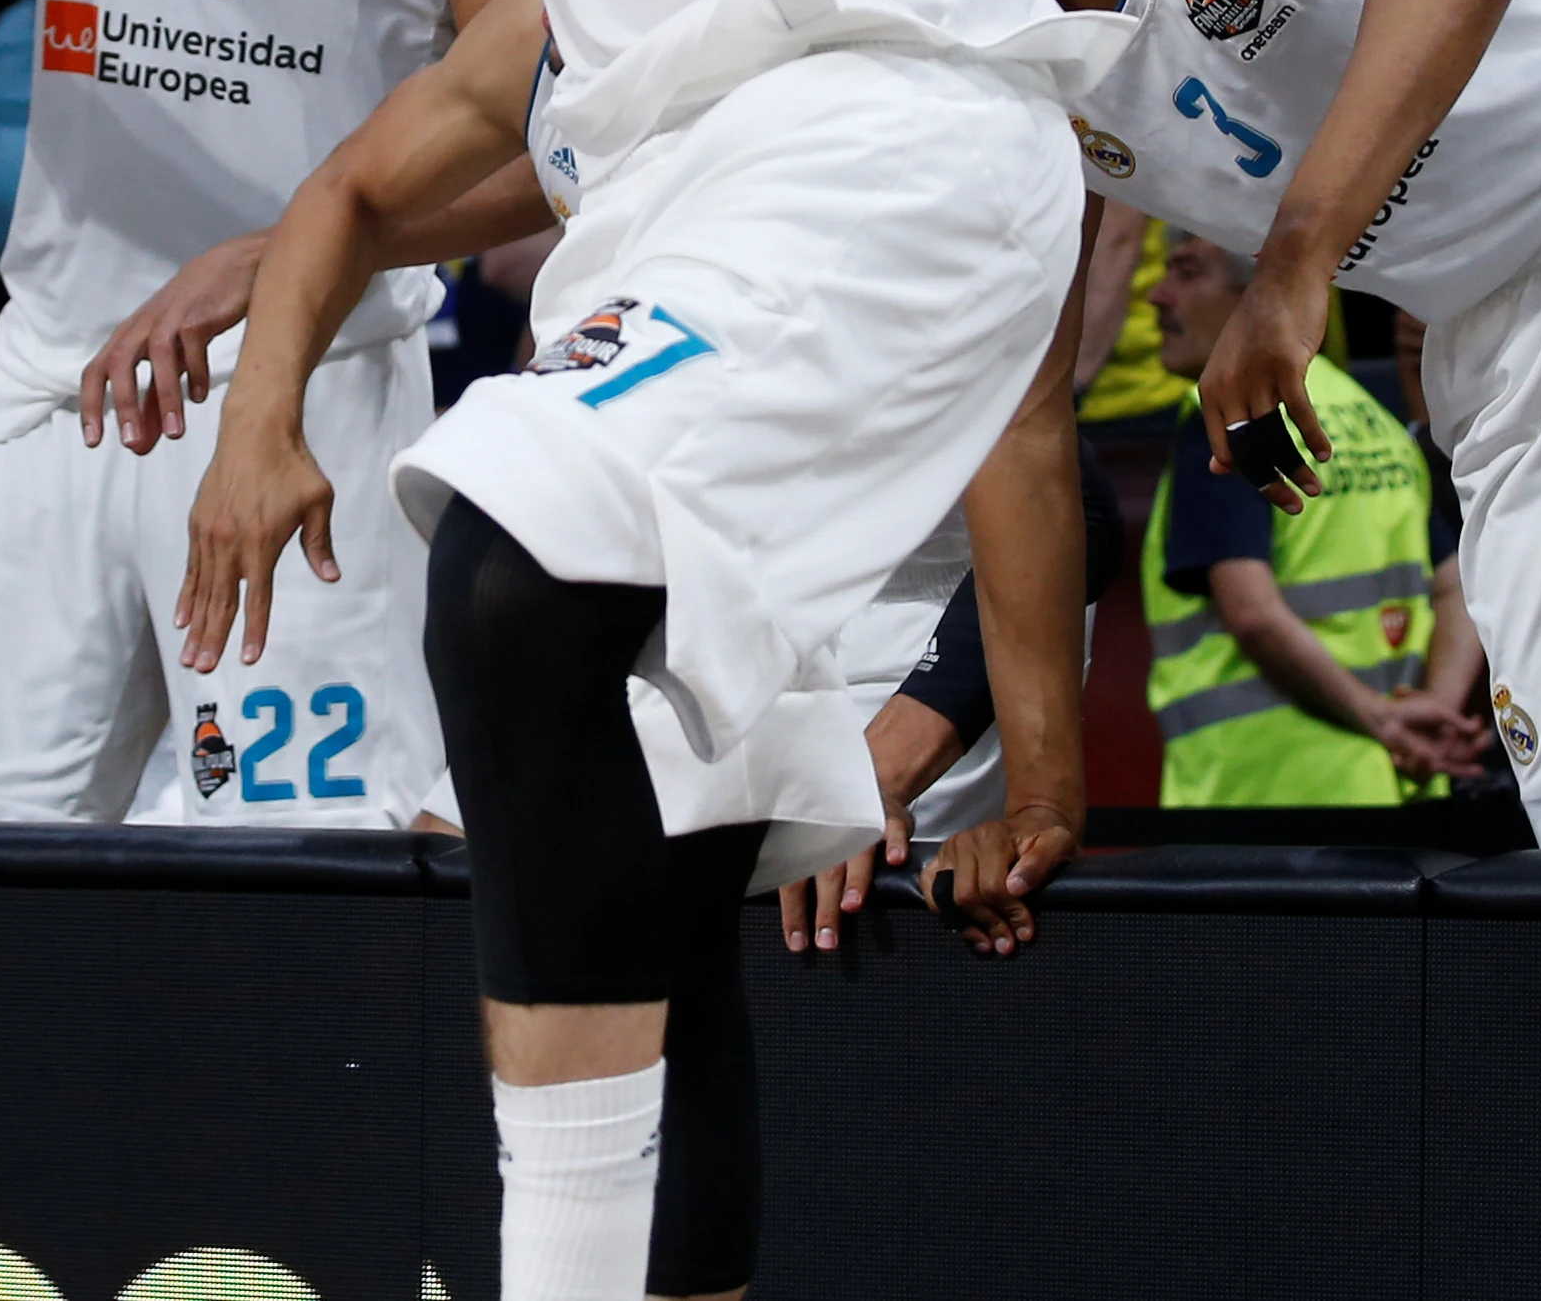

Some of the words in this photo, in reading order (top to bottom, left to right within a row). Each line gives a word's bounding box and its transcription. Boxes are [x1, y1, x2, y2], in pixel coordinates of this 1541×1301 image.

[101, 10, 325, 75] Universidad
[1193, 0, 1228, 34] FINAL
[1240, 4, 1296, 61] oneteam
[96, 50, 251, 105] Europea
[1172, 74, 1283, 179] 3
[1337, 138, 1440, 272] uropea
[576, 303, 718, 411] 7
[239, 681, 367, 803] 22
